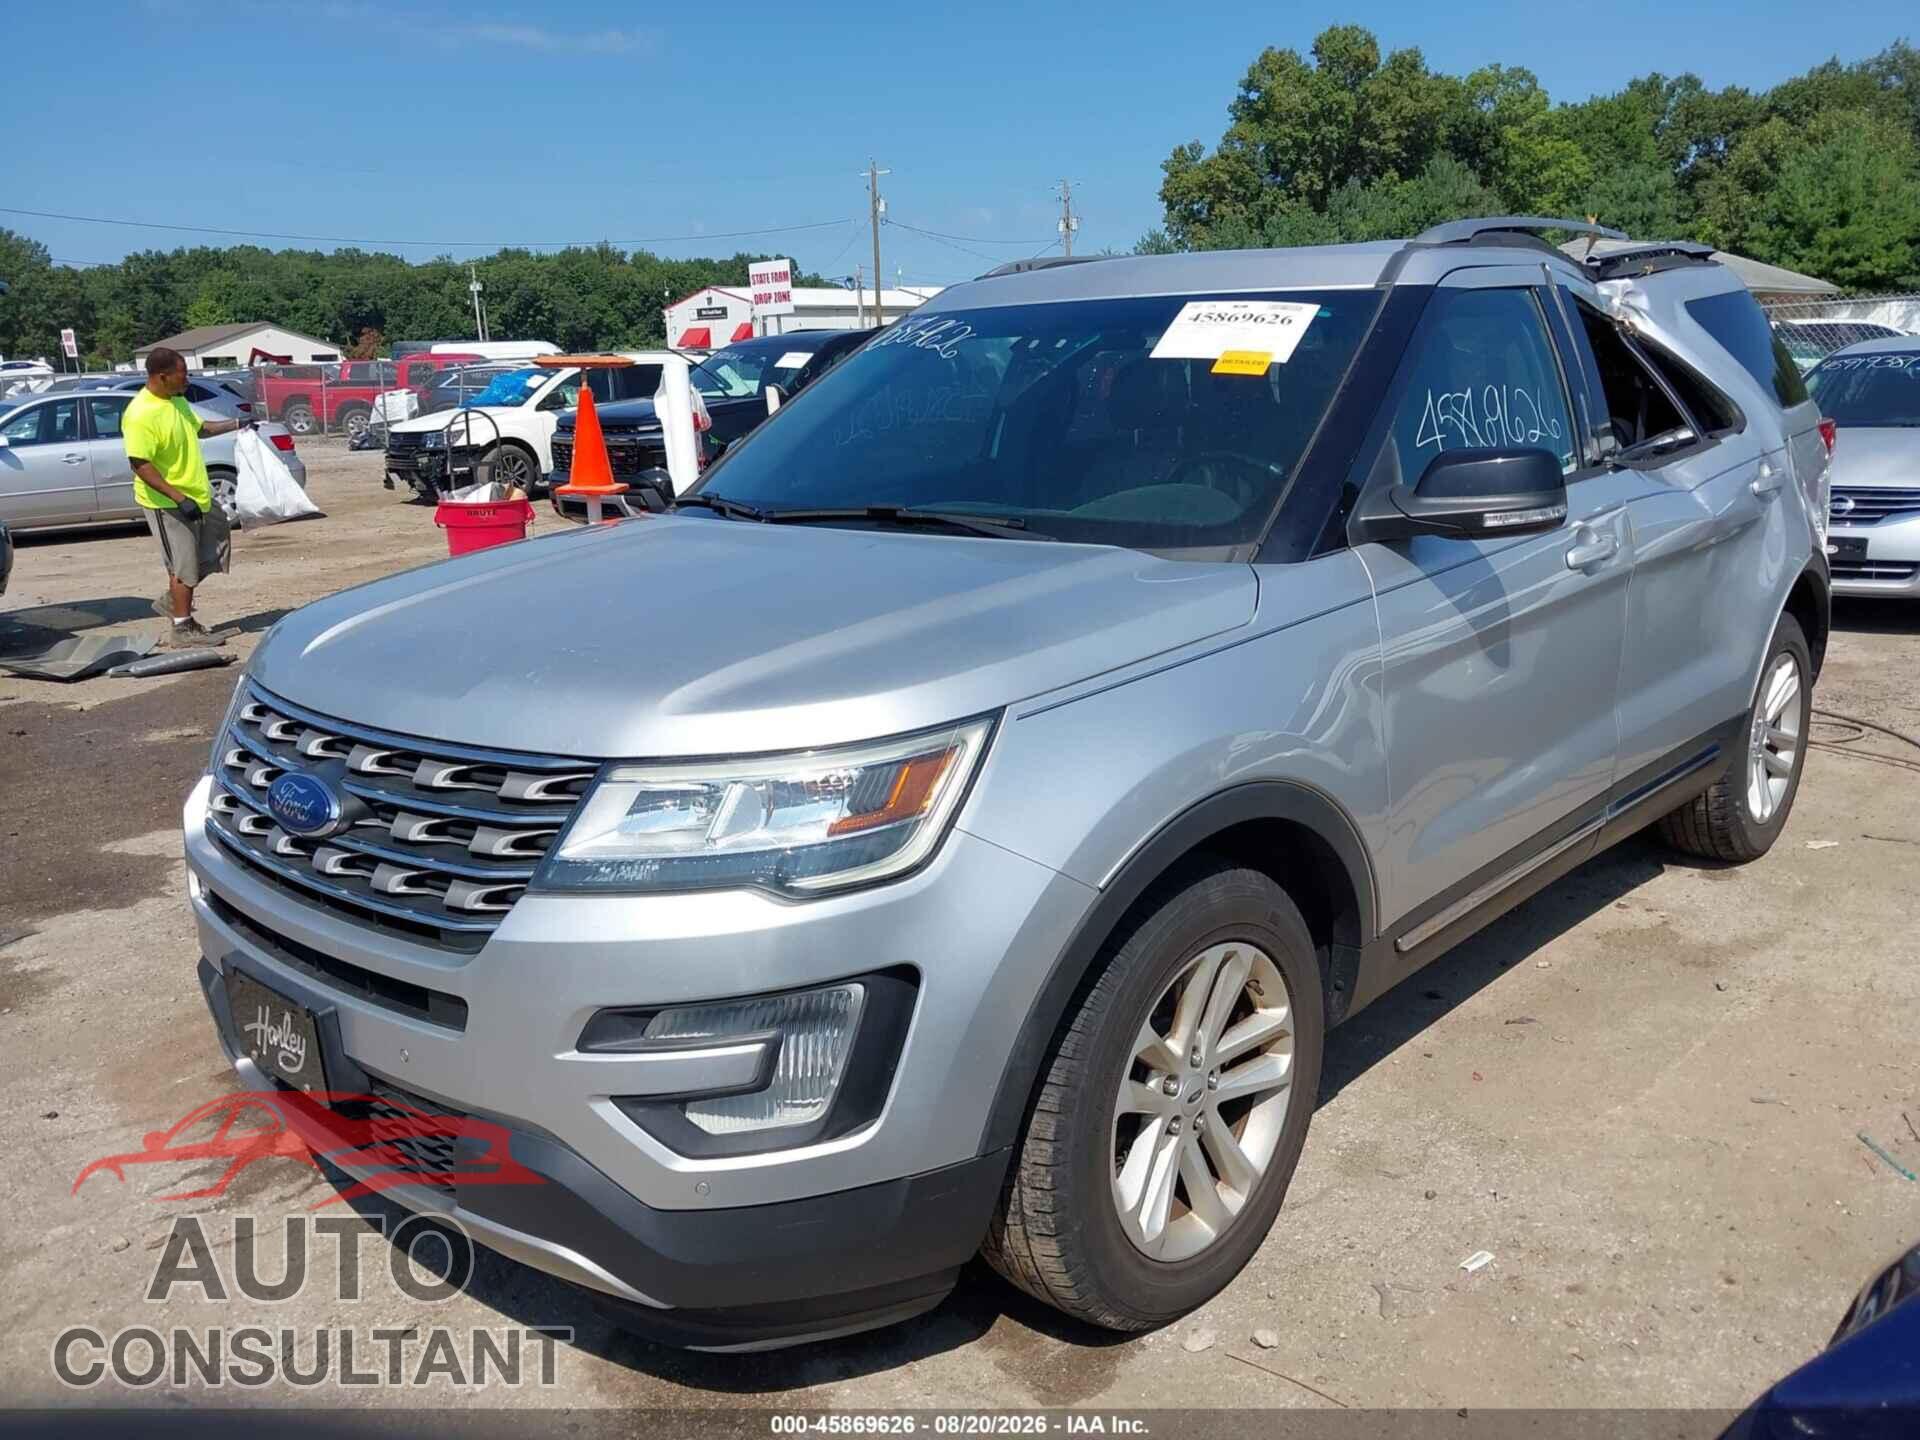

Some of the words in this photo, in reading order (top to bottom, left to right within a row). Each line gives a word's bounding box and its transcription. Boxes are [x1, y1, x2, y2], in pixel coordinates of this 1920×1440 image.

[751, 272, 770, 285] STATE
[771, 270, 789, 283] FARM
[754, 292, 771, 305] DROP
[774, 290, 791, 303] ZONE
[1188, 311, 1293, 327] 45869626
[275, 781, 315, 822] Ford
[243, 1005, 306, 1073] Harley
